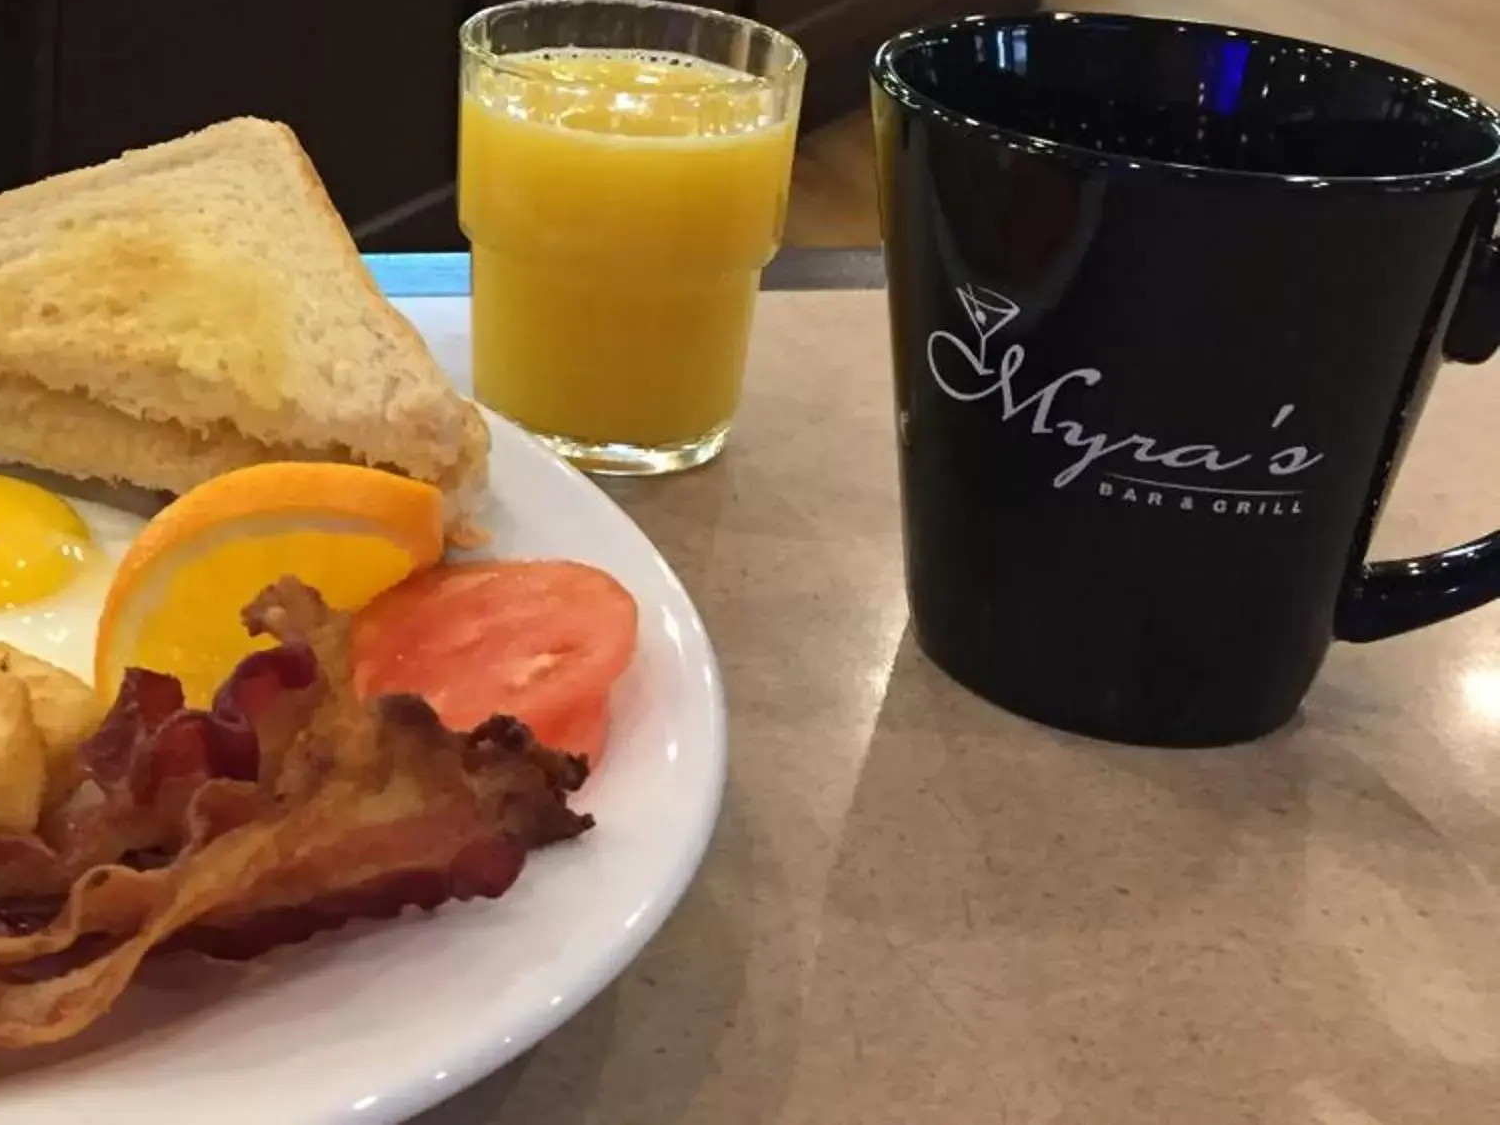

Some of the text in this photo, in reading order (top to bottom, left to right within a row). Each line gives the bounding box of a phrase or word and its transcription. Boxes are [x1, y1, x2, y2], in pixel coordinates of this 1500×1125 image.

[927, 330, 1324, 488] Myra's
[1099, 482, 1301, 515] BAR & GRILL
